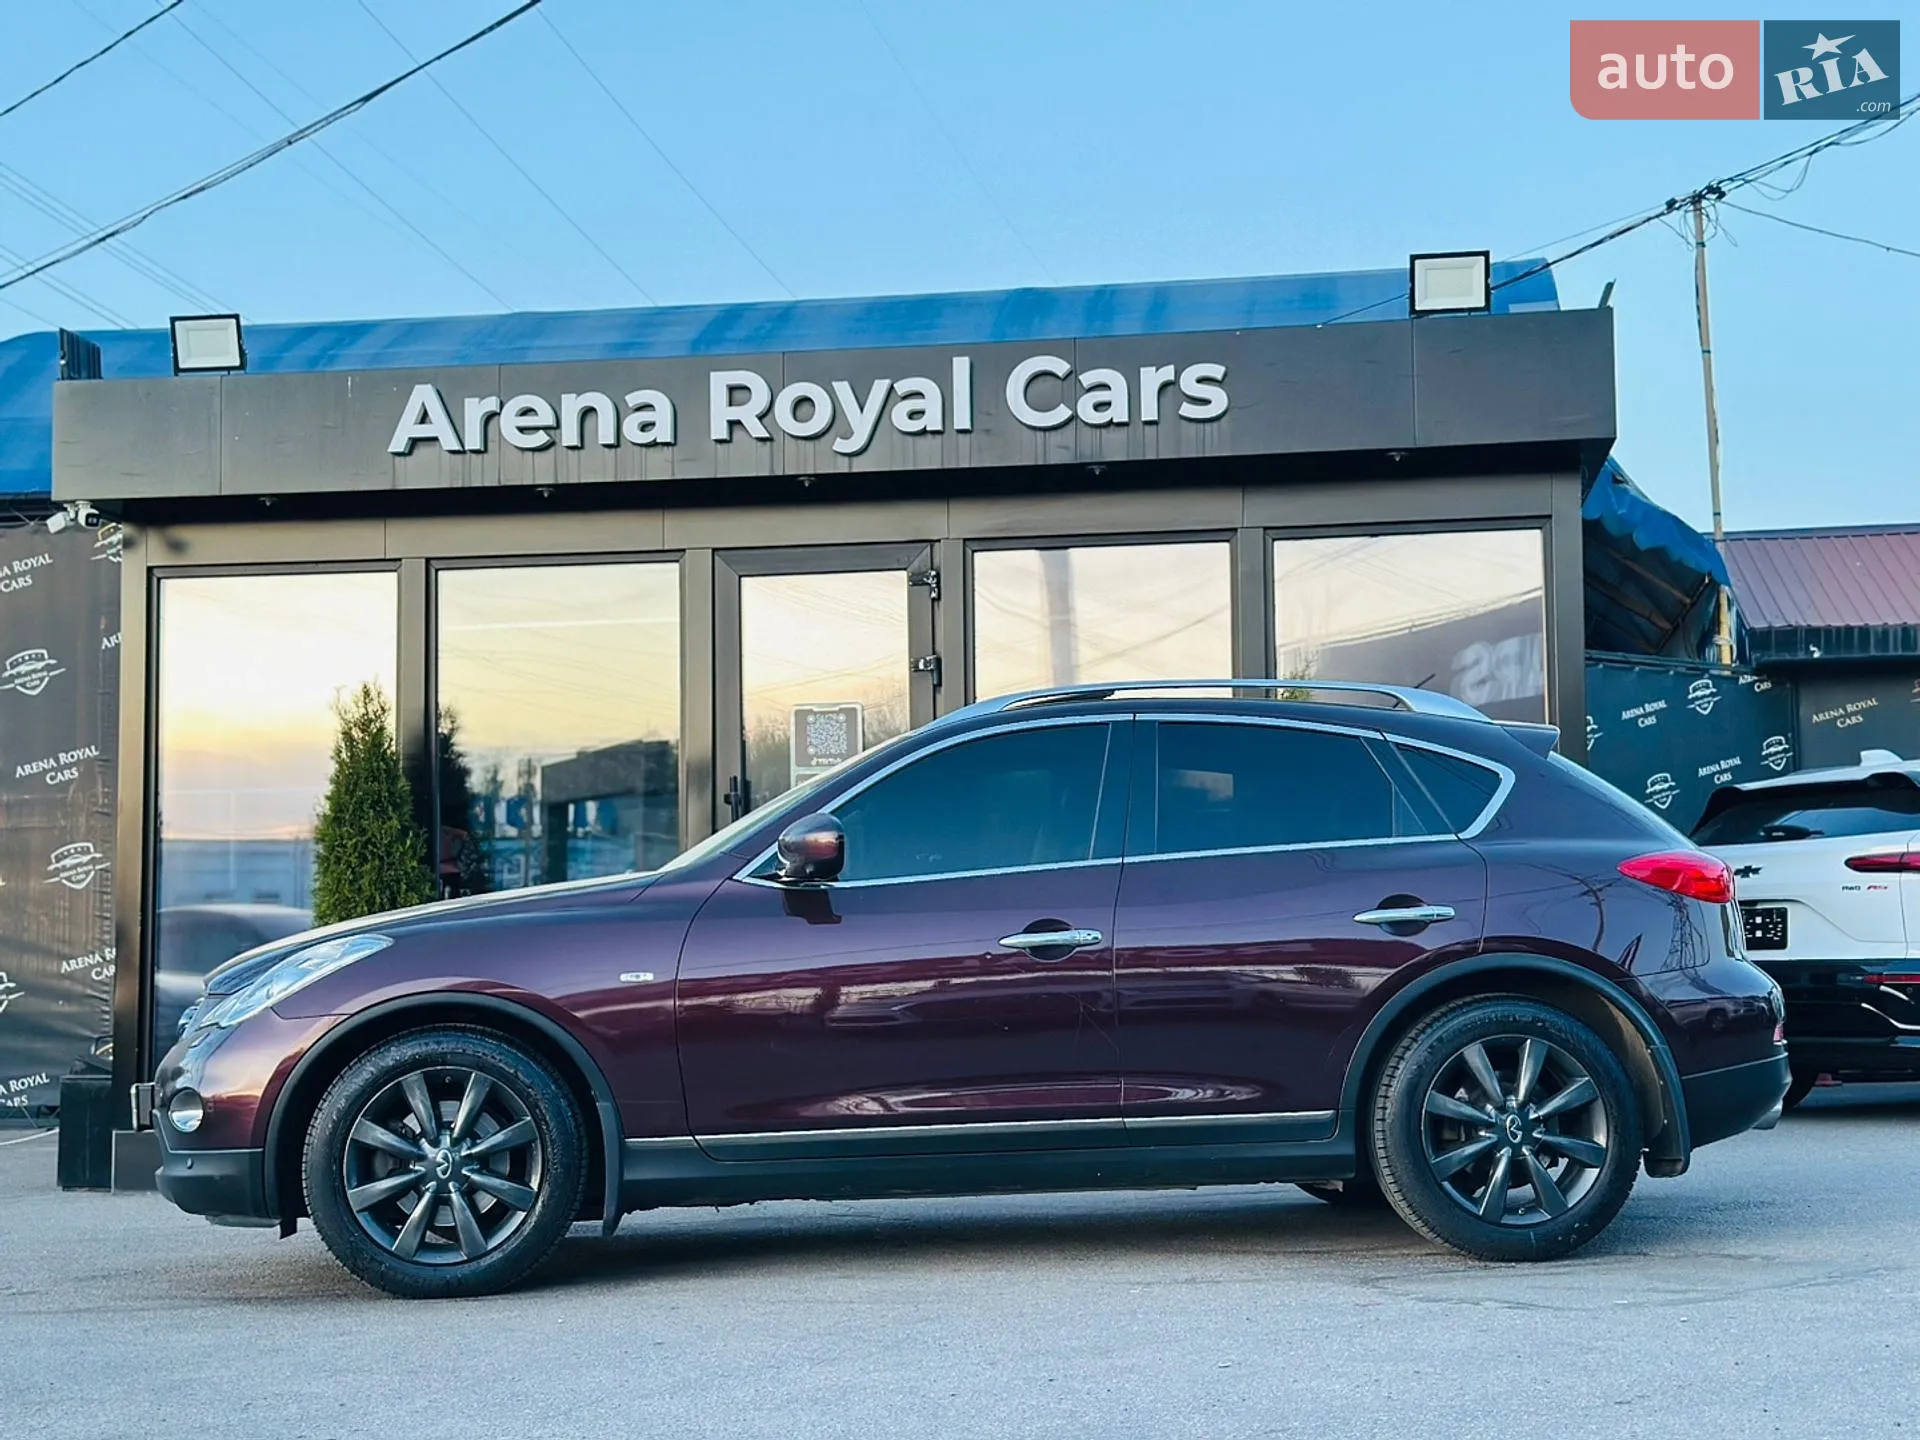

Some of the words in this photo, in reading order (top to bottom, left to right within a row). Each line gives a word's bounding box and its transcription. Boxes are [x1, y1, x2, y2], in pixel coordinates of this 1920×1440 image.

[387, 383, 676, 456] Arena
[708, 356, 973, 456] Royal
[1005, 355, 1230, 430] Cars
[12, 552, 53, 573] ROYAL
[0, 574, 33, 592] CARS
[1812, 707, 1845, 723] ARENA
[1845, 697, 1878, 713] ROYAL
[1836, 714, 1864, 728] CARS
[15, 757, 58, 778] ARENA
[58, 745, 100, 765] ROYAL
[45, 766, 79, 785] CARS
[60, 952, 103, 974] ARENA
[91, 964, 116, 981] CAR
[9, 1072, 50, 1092] ROYAL
